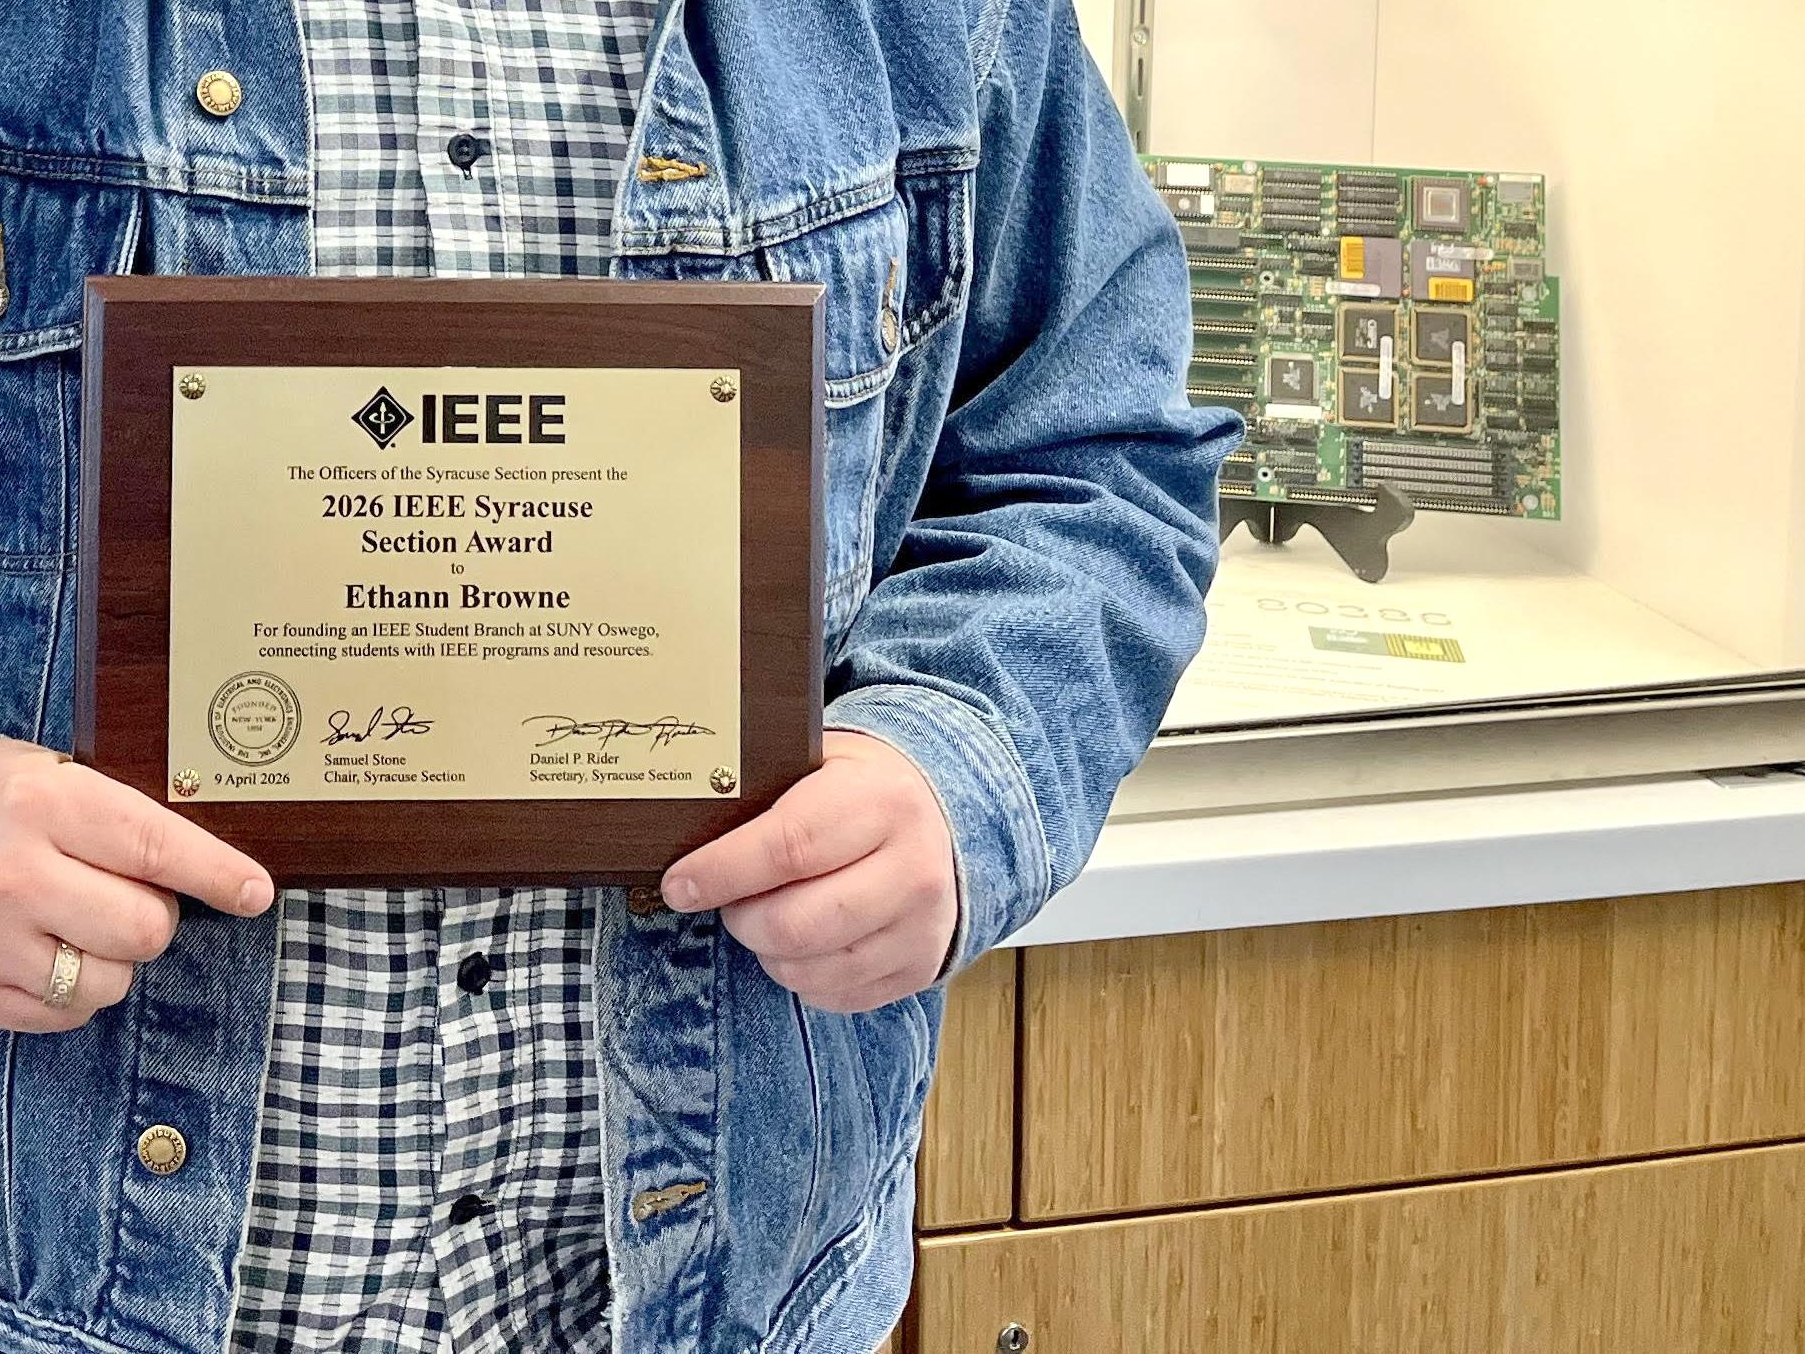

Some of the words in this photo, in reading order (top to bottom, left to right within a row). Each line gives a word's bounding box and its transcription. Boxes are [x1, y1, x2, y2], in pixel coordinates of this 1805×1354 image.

[421, 394, 566, 444] IEEE
[286, 465, 315, 480] The
[319, 465, 377, 480] Officers
[381, 465, 398, 480] of
[400, 465, 422, 480] the
[426, 465, 490, 484] Syracuse
[494, 465, 547, 481] Section
[551, 468, 602, 485] present
[606, 466, 628, 481] the
[321, 494, 384, 518] 2026
[392, 494, 466, 518] IEEE
[475, 494, 594, 525] Syracuse
[361, 529, 457, 554] Section
[465, 529, 553, 554] Award
[450, 562, 465, 576] to
[344, 583, 449, 610] Ethann
[459, 583, 571, 610] Browne
[253, 622, 279, 638] For
[282, 621, 347, 642] founding
[351, 626, 368, 637] an
[372, 622, 411, 638] IEEE
[415, 622, 469, 638] Student
[474, 622, 525, 638] Branch
[529, 623, 542, 637] at
[546, 622, 594, 637] SUNY
[598, 622, 660, 640] Oswego,
[258, 642, 337, 661] connecting
[341, 642, 400, 658] students
[404, 642, 436, 658] with
[440, 642, 478, 658] IEEE
[482, 645, 550, 661] programs
[553, 643, 580, 657] and
[583, 645, 654, 657] resources.
[324, 753, 369, 767] Samuel
[372, 753, 407, 767] Stone
[529, 752, 569, 765] Daniel
[587, 752, 620, 765] Rider
[214, 773, 223, 785] 9
[225, 773, 257, 788] April
[260, 772, 291, 785] 2026
[324, 770, 360, 785] Chair,
[363, 770, 418, 786] Syracuse
[421, 770, 466, 783] Section
[529, 768, 588, 783] Secretary,
[592, 769, 645, 784] Syracuse
[648, 768, 693, 782] Section
